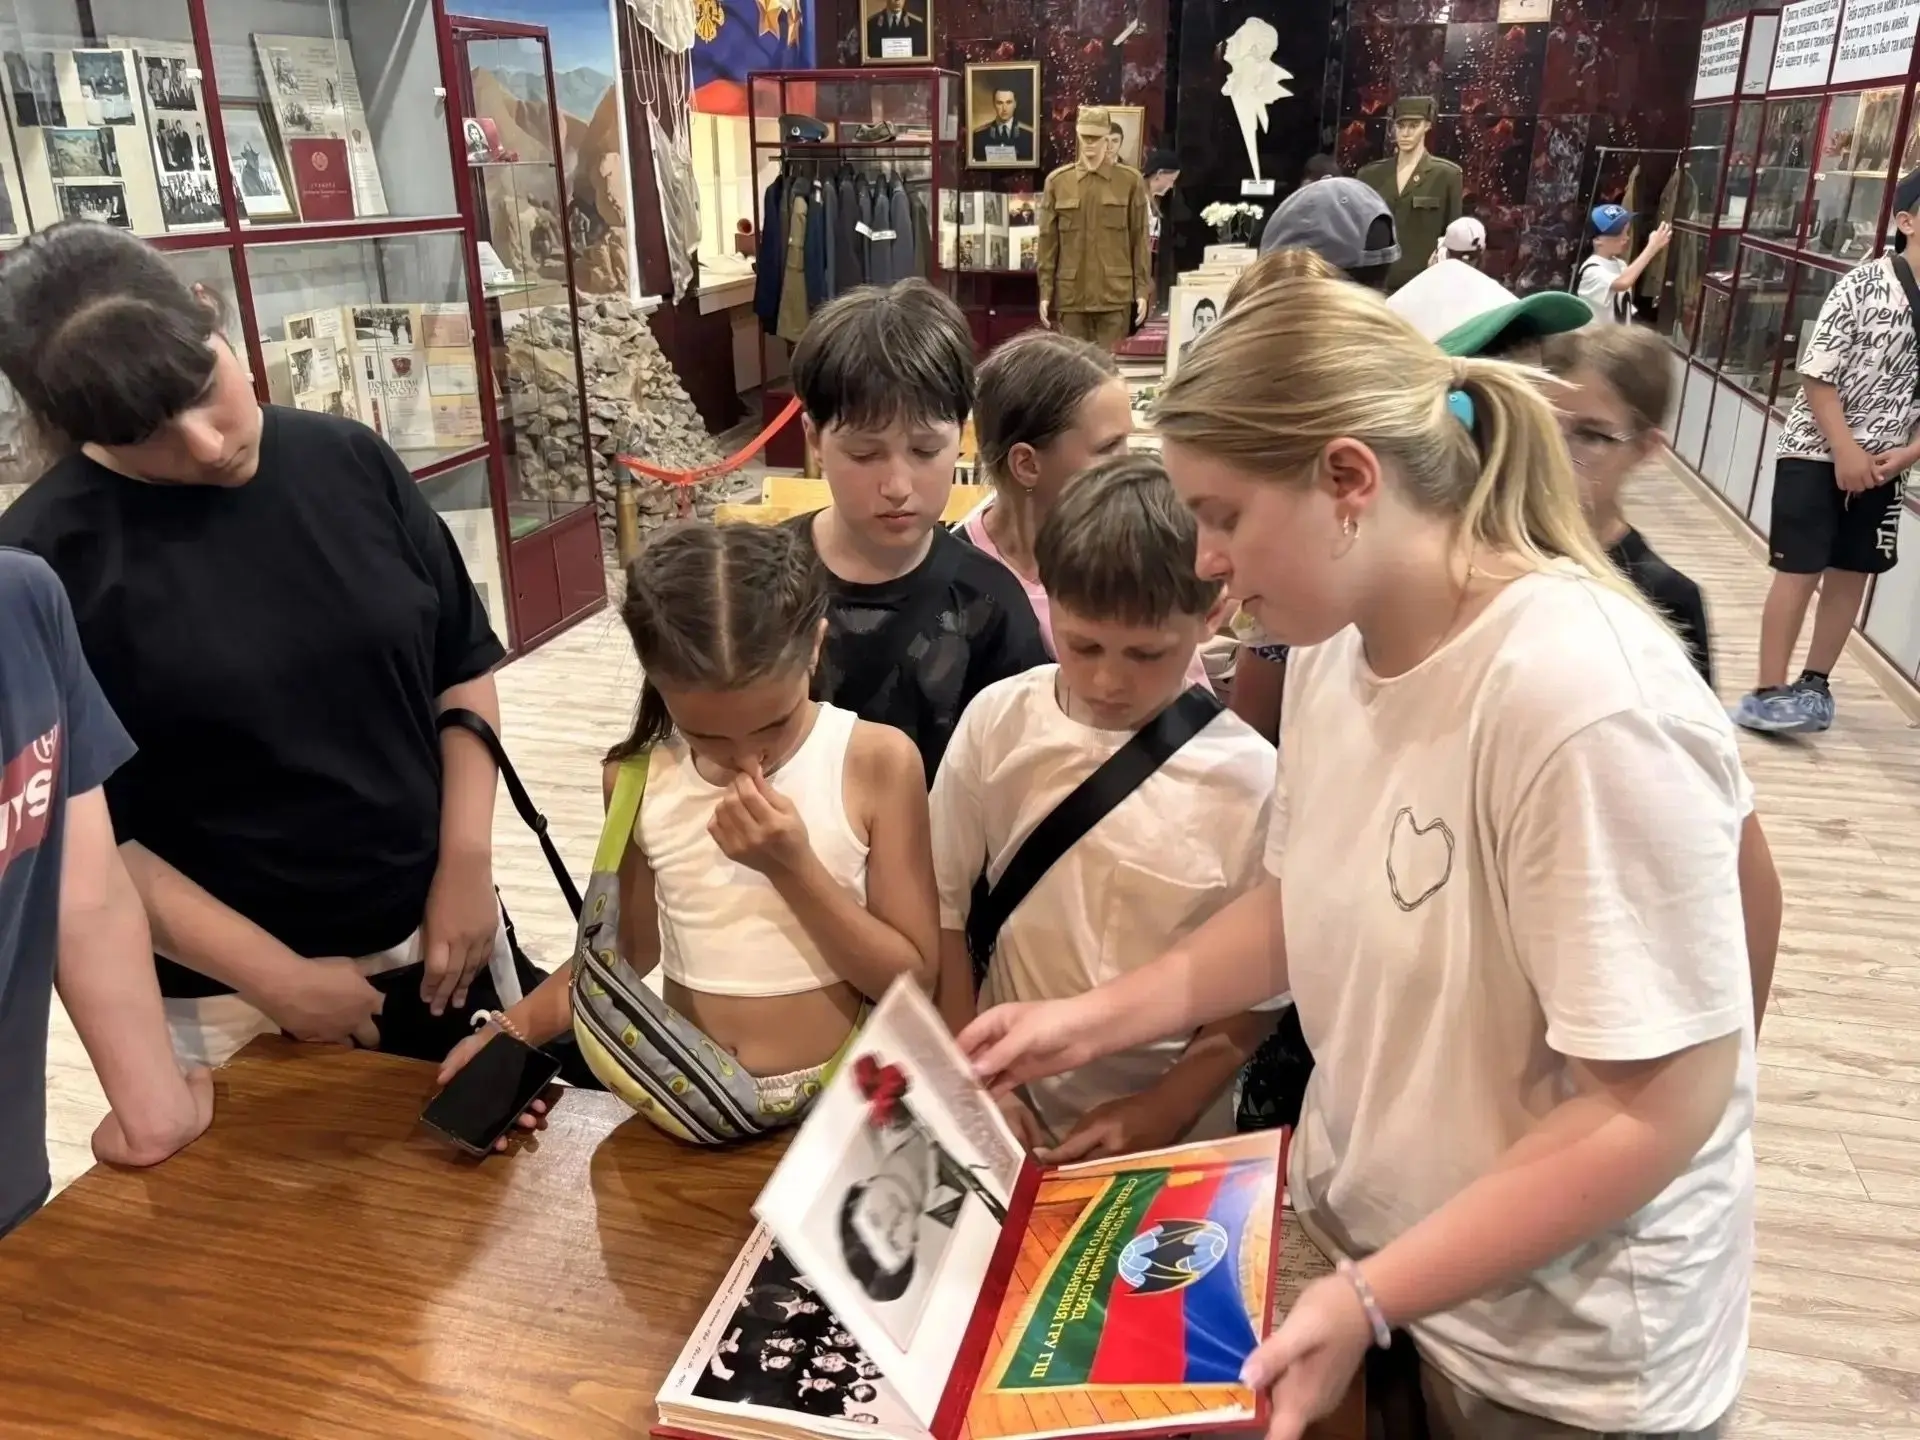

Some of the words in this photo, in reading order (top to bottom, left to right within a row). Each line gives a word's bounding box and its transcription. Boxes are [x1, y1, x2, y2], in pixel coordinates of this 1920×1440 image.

[1052, 1248, 1095, 1319] НАЗНАЧЕНИЯ
[1068, 1283, 1094, 1319] ОТРЯД
[1044, 1322, 1065, 1349] ГРУ
[1029, 1352, 1054, 1379] ГШ
